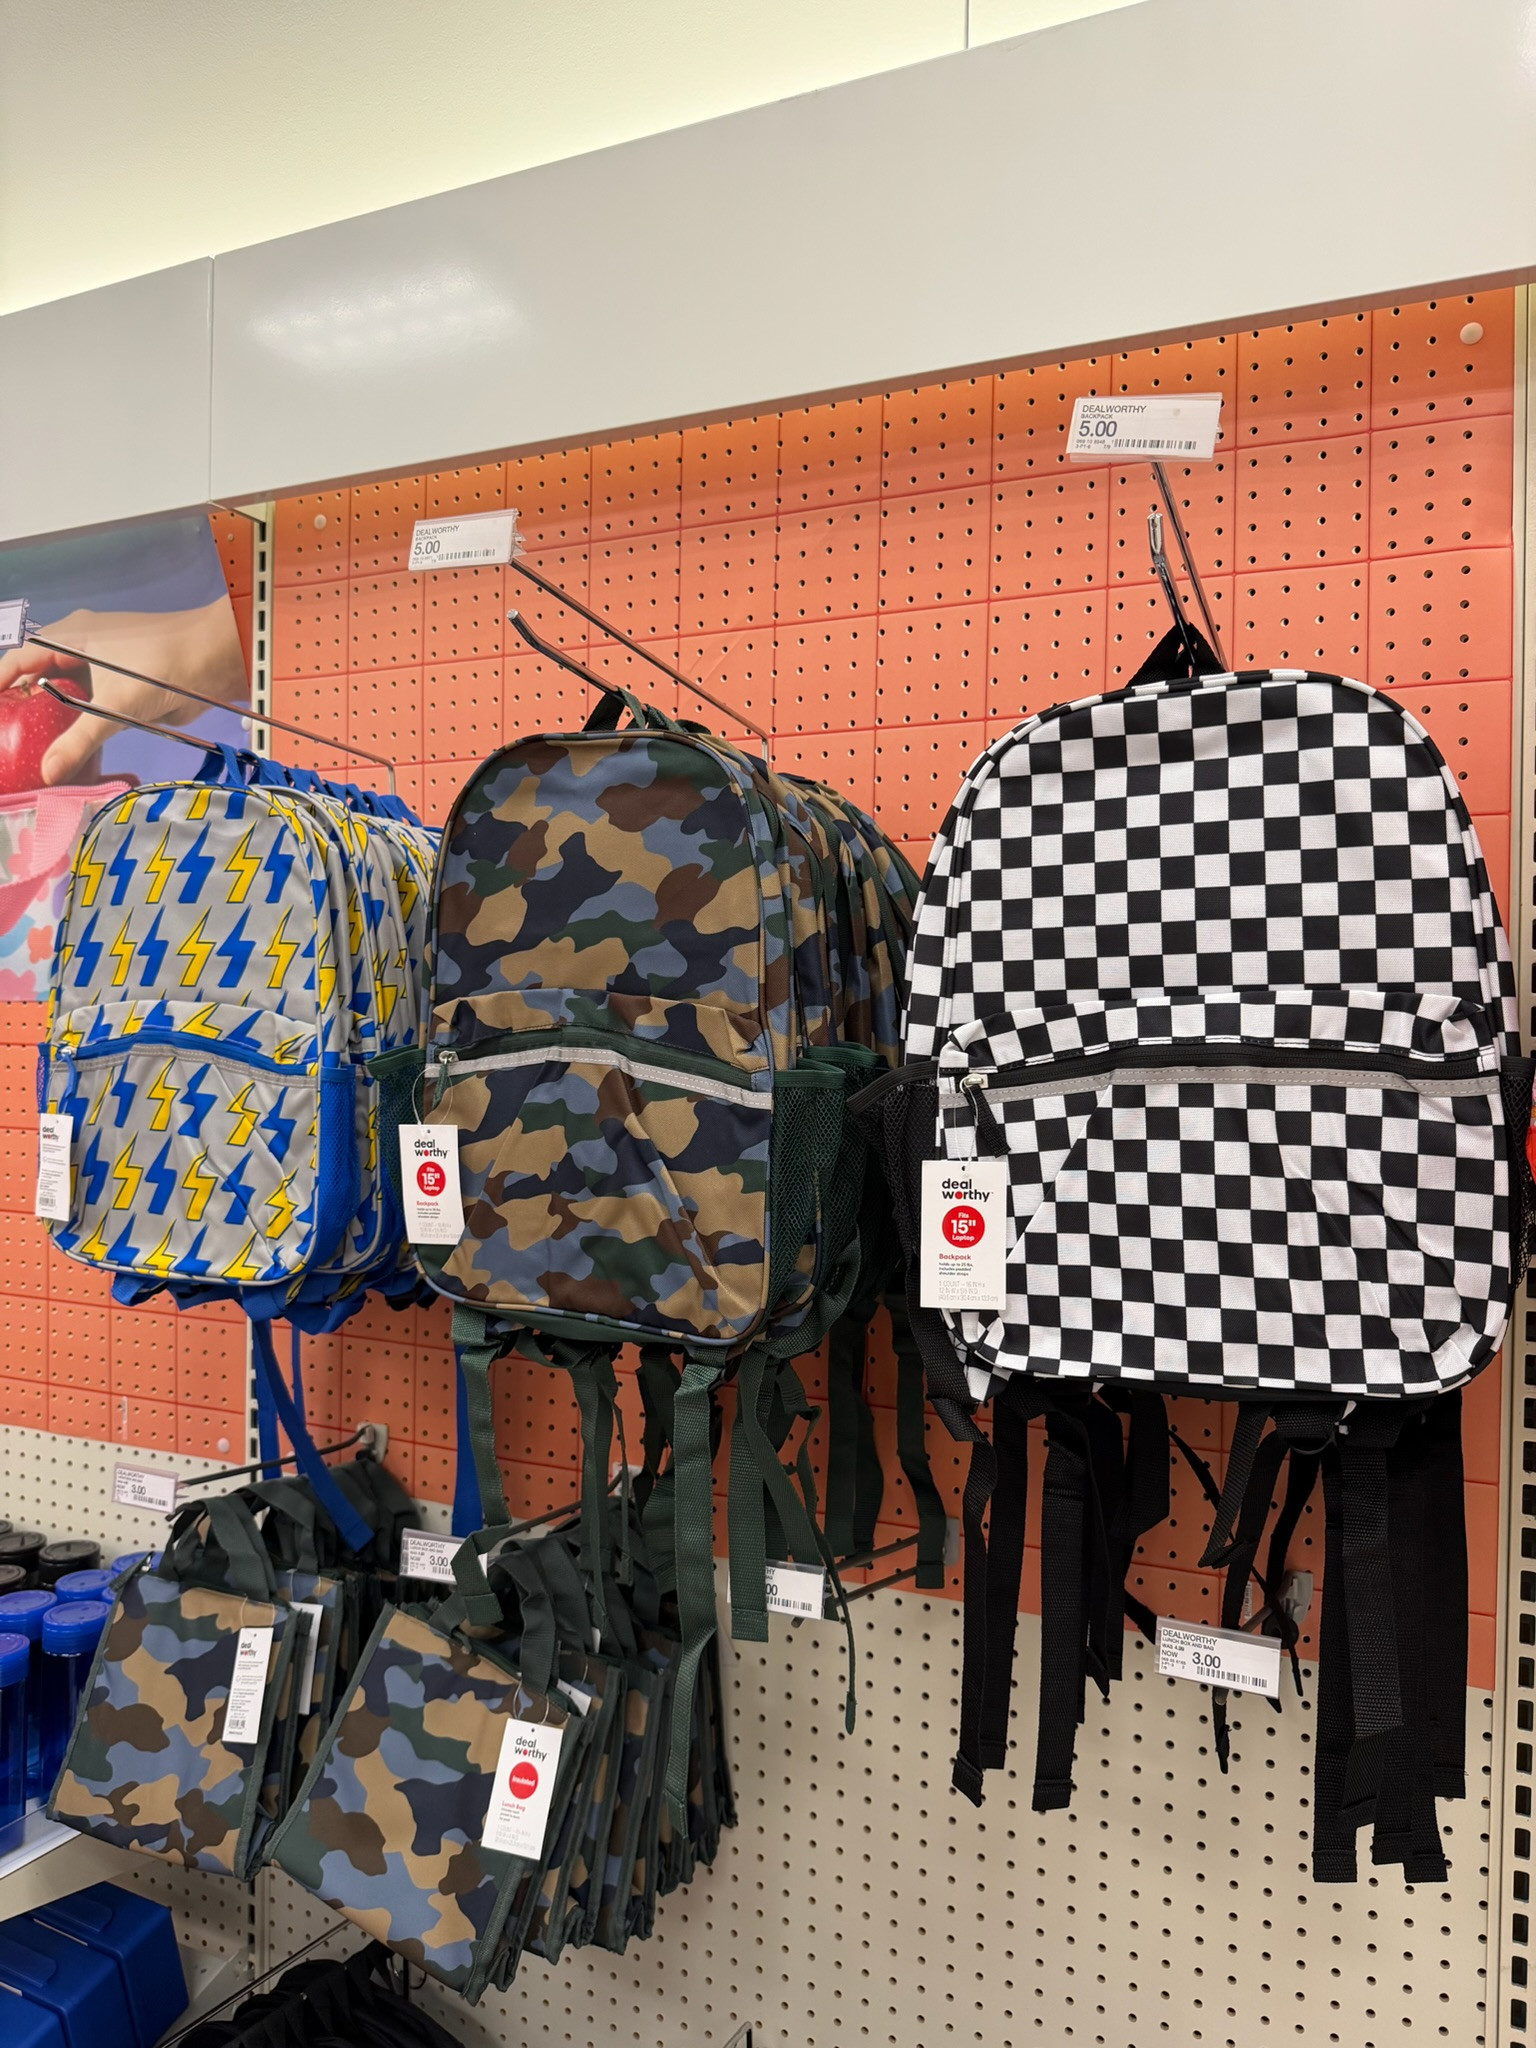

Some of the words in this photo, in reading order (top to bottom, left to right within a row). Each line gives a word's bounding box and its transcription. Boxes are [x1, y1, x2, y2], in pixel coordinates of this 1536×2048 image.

[1082, 405, 1147, 414] DEALWORTHY
[1079, 421, 1117, 437] 5.00
[415, 525, 460, 536] DEALWORTHY
[413, 540, 440, 556] 5.00
[414, 1139, 436, 1148] deal
[414, 1148, 448, 1159] worthy
[421, 1173, 440, 1185] 15"
[942, 1178, 972, 1189] deal
[942, 1189, 990, 1202] worthy
[951, 1219, 976, 1234] 15"
[939, 1253, 972, 1261] Backpack
[131, 1484, 146, 1495] 3.00
[410, 1539, 446, 1549] DEALWORTHY
[429, 1555, 449, 1567] 3.00
[1162, 1629, 1218, 1646] DEALWORTHY
[1161, 1649, 1179, 1657] NOW
[1192, 1651, 1221, 1668] 3.00
[515, 1736, 537, 1748] deal
[514, 1746, 548, 1762] worthy
[516, 1803, 526, 1812] Bag
